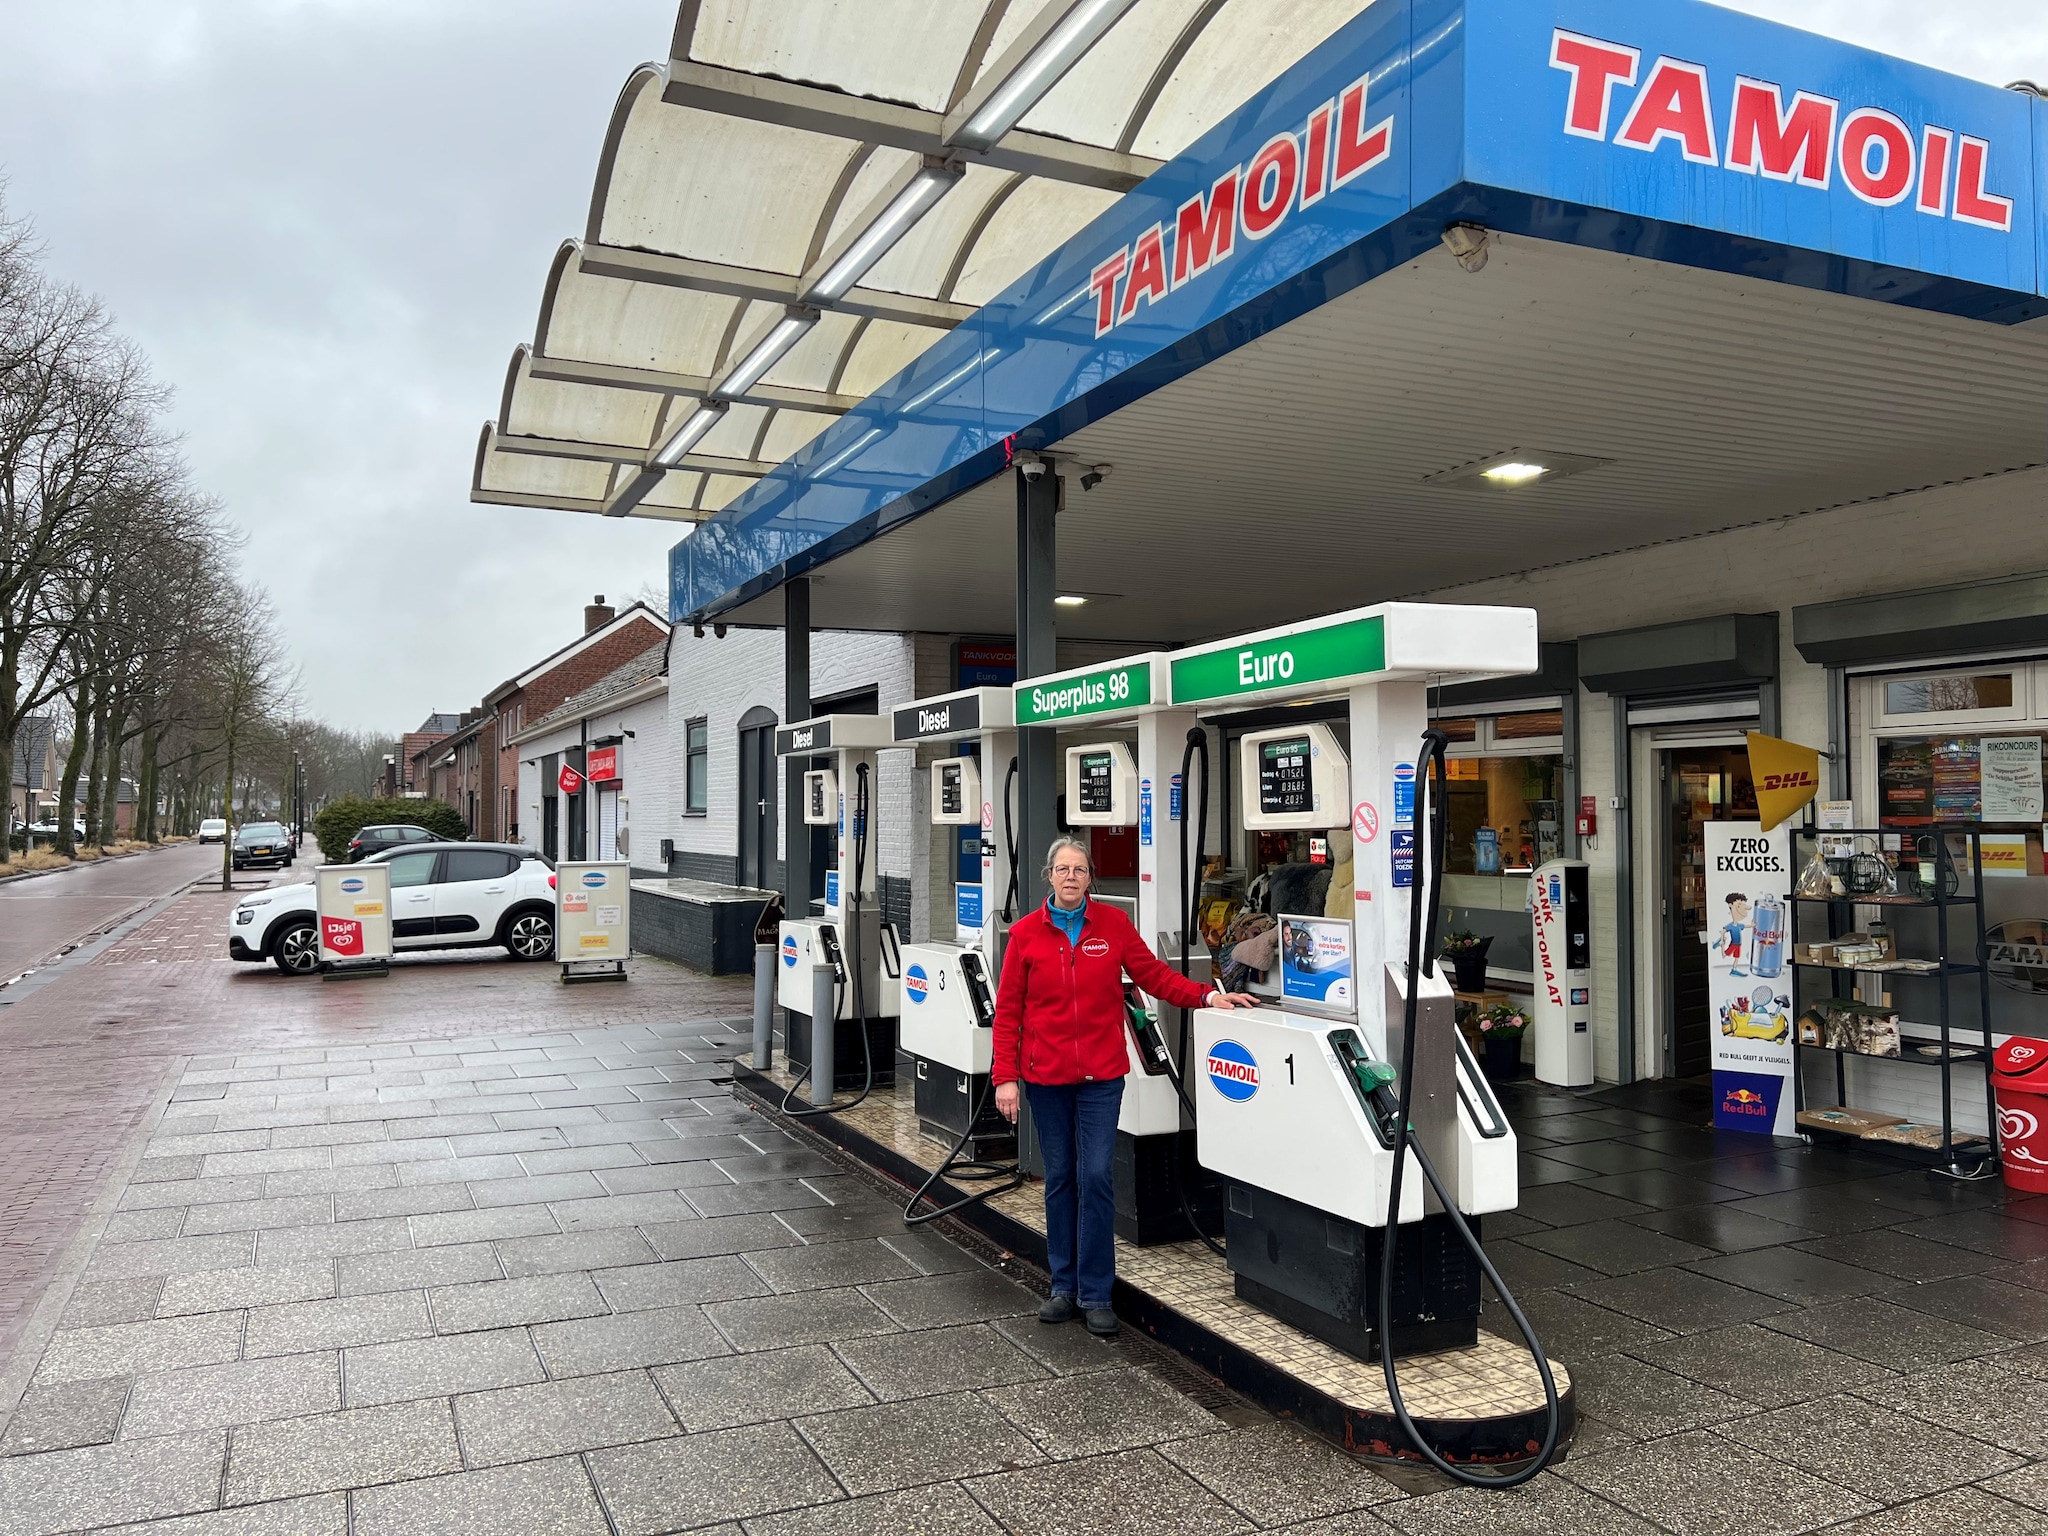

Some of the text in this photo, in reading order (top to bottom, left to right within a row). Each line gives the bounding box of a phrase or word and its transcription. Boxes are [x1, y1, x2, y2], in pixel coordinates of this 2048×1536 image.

[1549, 28, 2013, 233] TAMOIL
[1089, 72, 1394, 341] TAMOIL
[976, 671, 998, 681] Euro
[1238, 651, 1295, 686] Euro
[1032, 671, 1130, 716] Superplus 98
[918, 705, 950, 733] Diesel
[792, 728, 813, 749] Diesel
[1987, 741, 2038, 752] RIKCONCOURS
[1276, 744, 1298, 755] Euro 95
[1931, 744, 1964, 755] CARNAAL
[1764, 772, 1812, 790] DHL
[1730, 838, 1770, 854] ZERO
[1717, 856, 1785, 872] EXCUSES.
[1981, 851, 2017, 861] DHL
[1536, 874, 1555, 924] TANK
[328, 922, 356, 934] IJsje?
[1753, 928, 1784, 939] Red Bull
[783, 946, 798, 957] TAMOIL
[805, 939, 810, 956] 4
[1330, 943, 1345, 951] korting
[1531, 902, 1564, 1007] AUTOMAAT
[906, 976, 928, 992] TAMOIL
[939, 969, 945, 991] 3
[1743, 1054, 1757, 1062] GEEFT
[1765, 1056, 1792, 1065] VLEUGELS.
[1207, 1057, 1259, 1084] TAMOIL
[1284, 1053, 1294, 1085] 1
[1722, 1101, 1767, 1116] Red Bull
